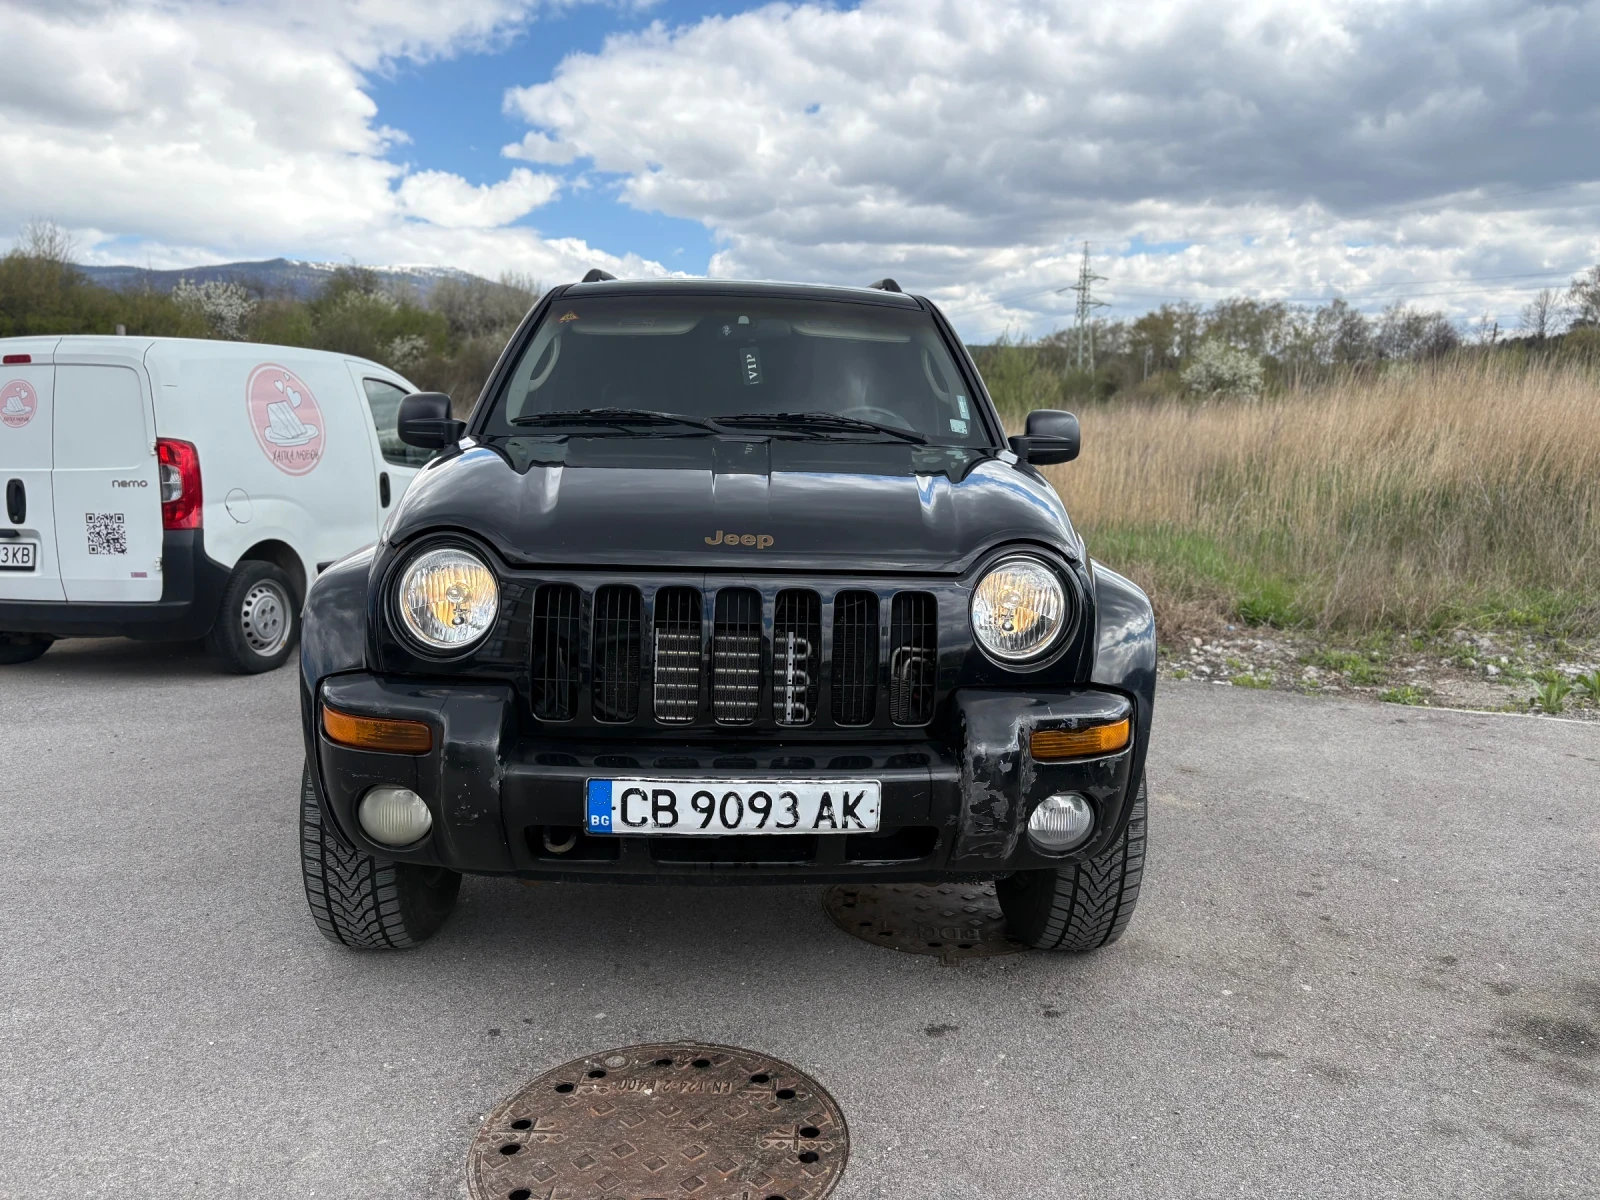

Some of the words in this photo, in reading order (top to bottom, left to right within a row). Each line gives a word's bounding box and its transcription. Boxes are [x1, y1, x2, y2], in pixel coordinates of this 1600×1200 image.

[746, 354, 758, 380] VIP
[112, 480, 148, 488] nemo
[704, 530, 774, 549] Jeep
[0, 547, 9, 563] 3
[12, 547, 30, 564] KB
[620, 787, 679, 828] CB
[691, 790, 800, 829] 9093
[812, 790, 867, 829] AK
[591, 815, 610, 826] BG
